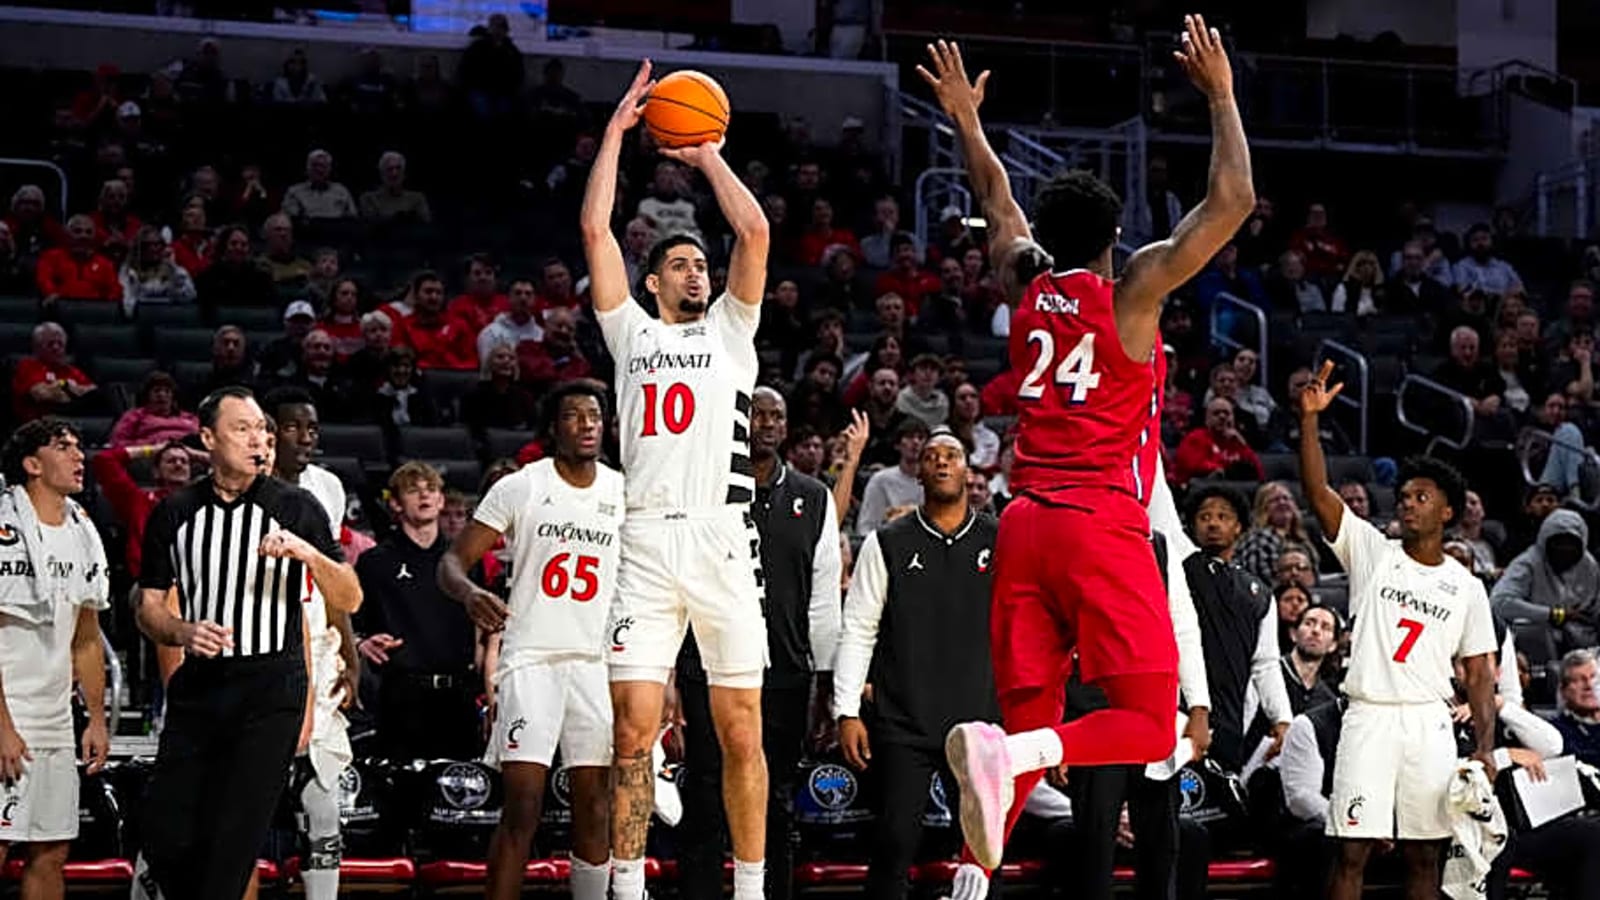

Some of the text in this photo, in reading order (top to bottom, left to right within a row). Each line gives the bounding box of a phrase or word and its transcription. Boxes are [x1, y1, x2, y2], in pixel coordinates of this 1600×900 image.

[629, 351, 712, 374] CINCINNATI
[1018, 329, 1101, 404] 24
[640, 382, 696, 438] 10
[537, 522, 613, 546] CINCINNATI
[541, 552, 600, 602] 65
[1393, 617, 1425, 663] 7
